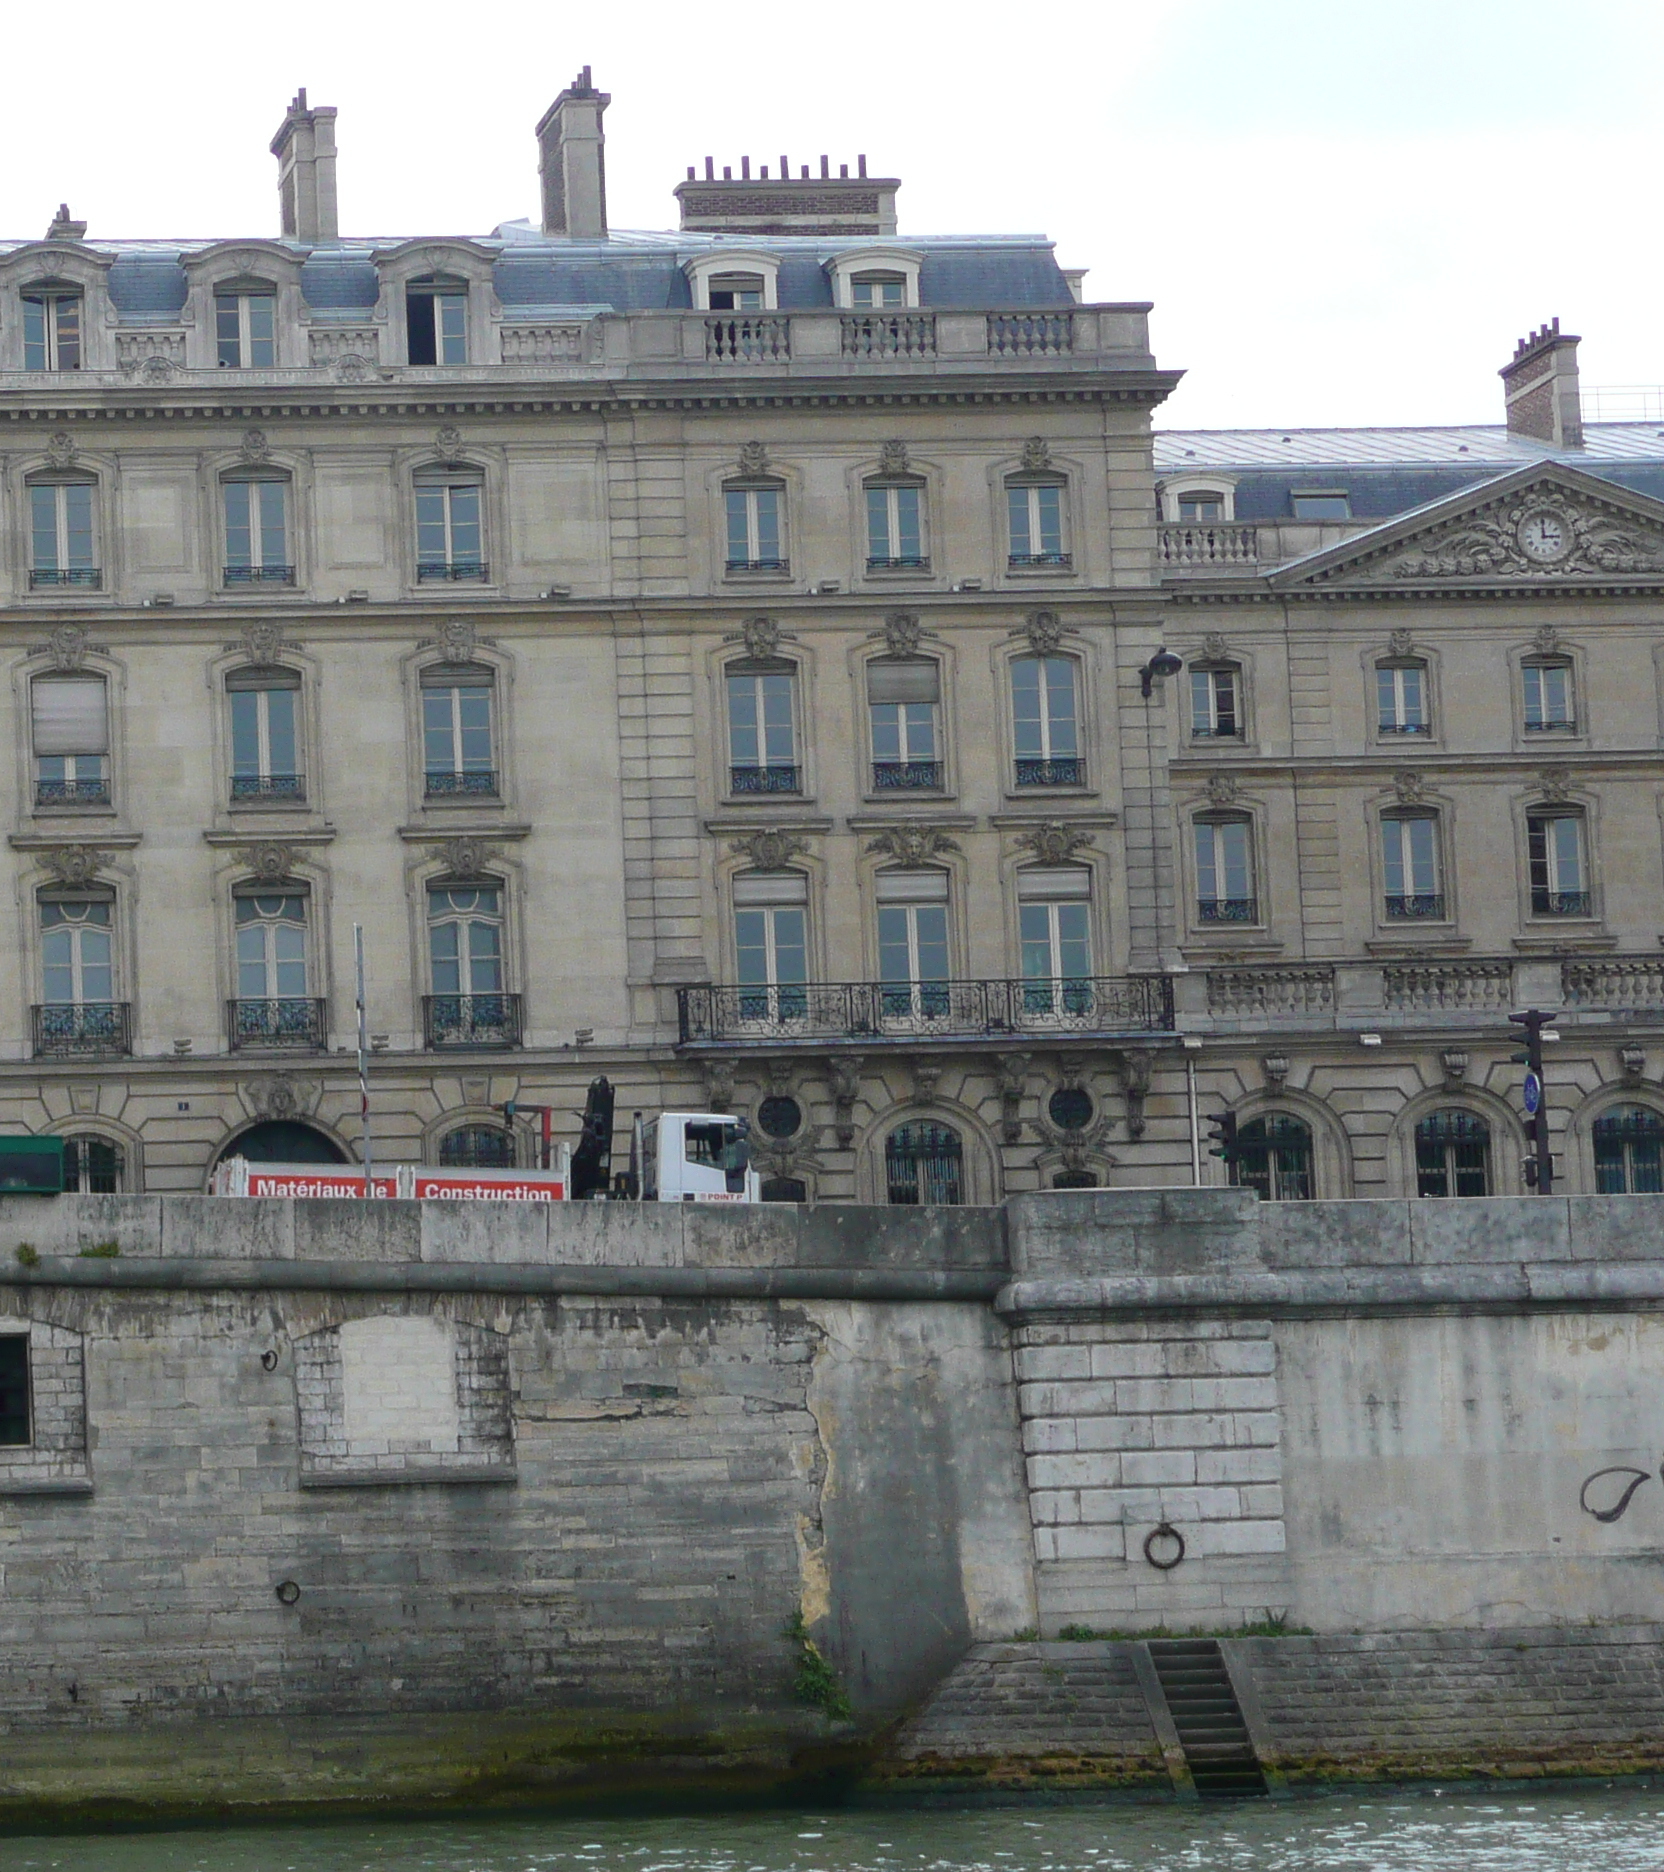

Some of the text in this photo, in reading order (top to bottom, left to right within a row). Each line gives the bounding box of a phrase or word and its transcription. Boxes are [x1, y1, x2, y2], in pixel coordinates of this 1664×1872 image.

[257, 1179, 357, 1198] Matériaux
[424, 1184, 551, 1200] Construction
[708, 1193, 735, 1201] POINT
